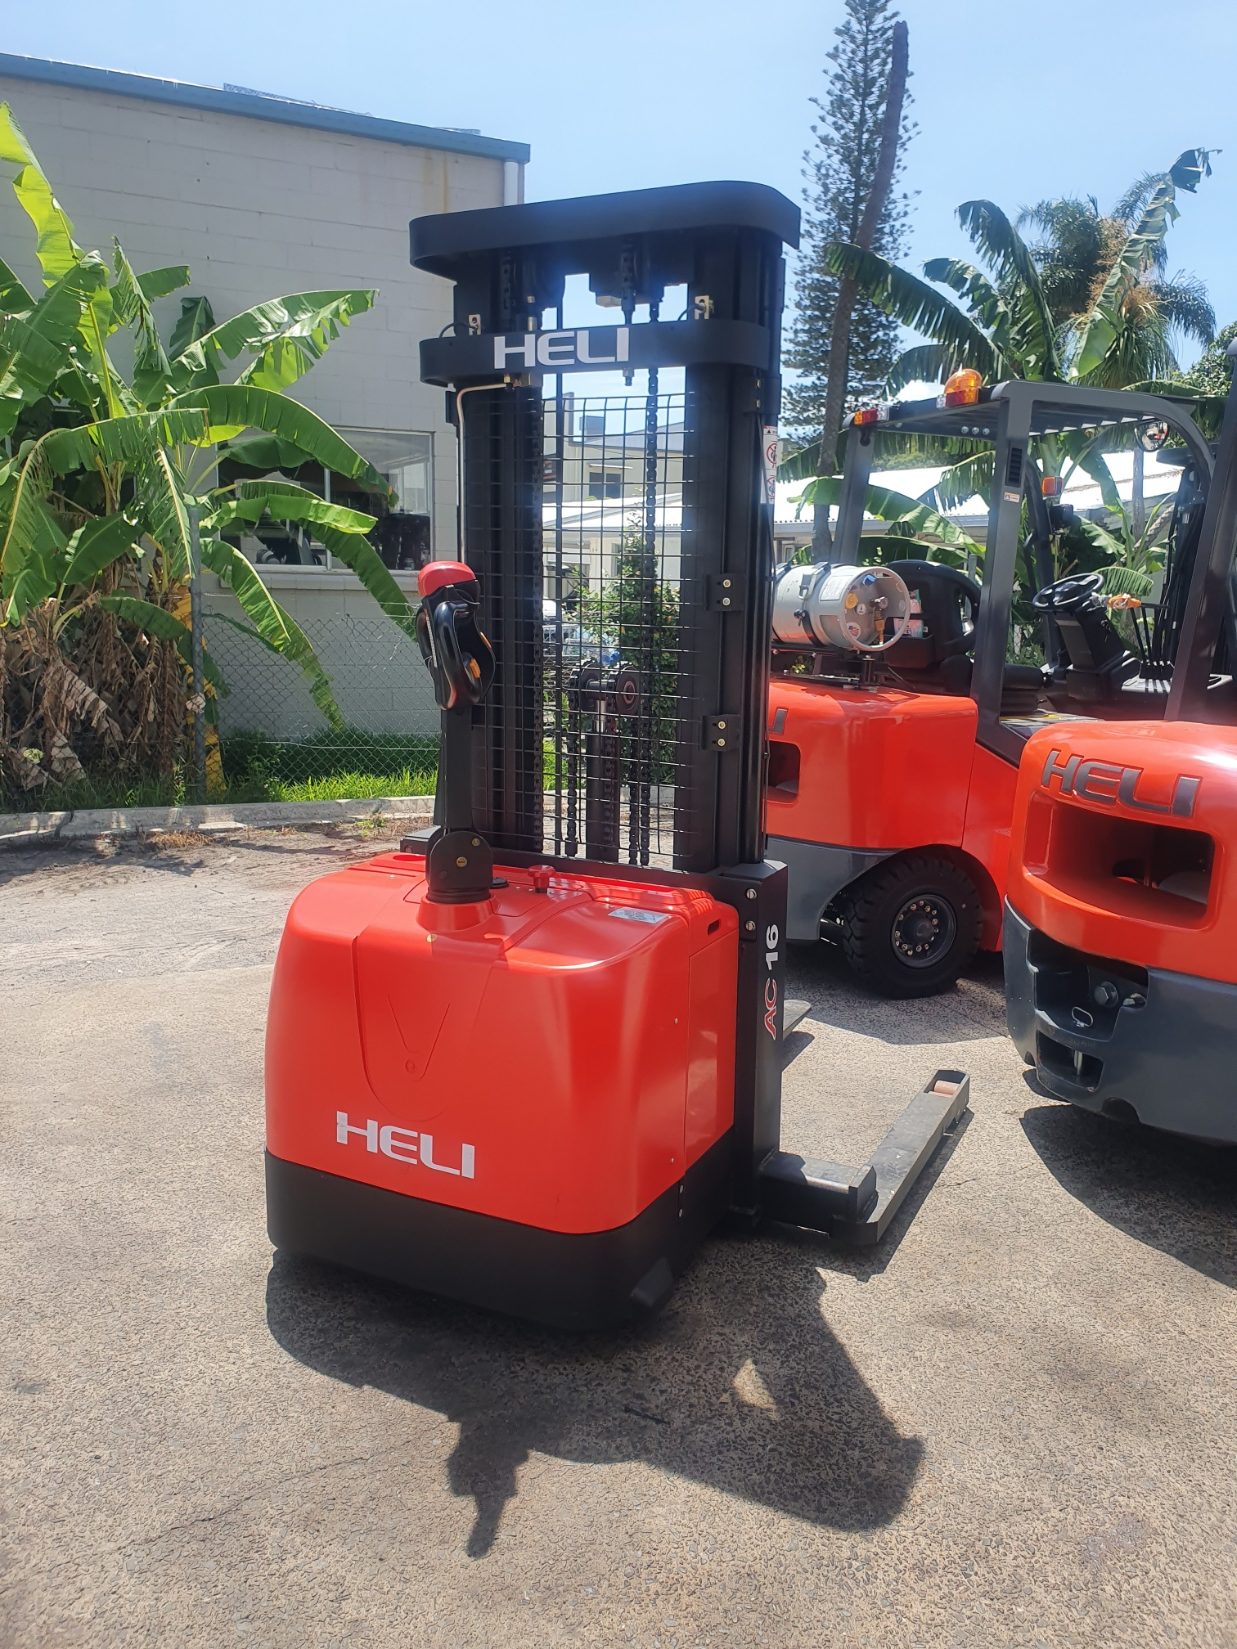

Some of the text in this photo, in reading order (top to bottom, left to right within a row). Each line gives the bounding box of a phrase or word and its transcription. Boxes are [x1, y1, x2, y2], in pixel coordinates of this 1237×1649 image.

[493, 327, 630, 370] HELI
[1040, 748, 1203, 818] HELI
[336, 1110, 476, 1180] HELI
